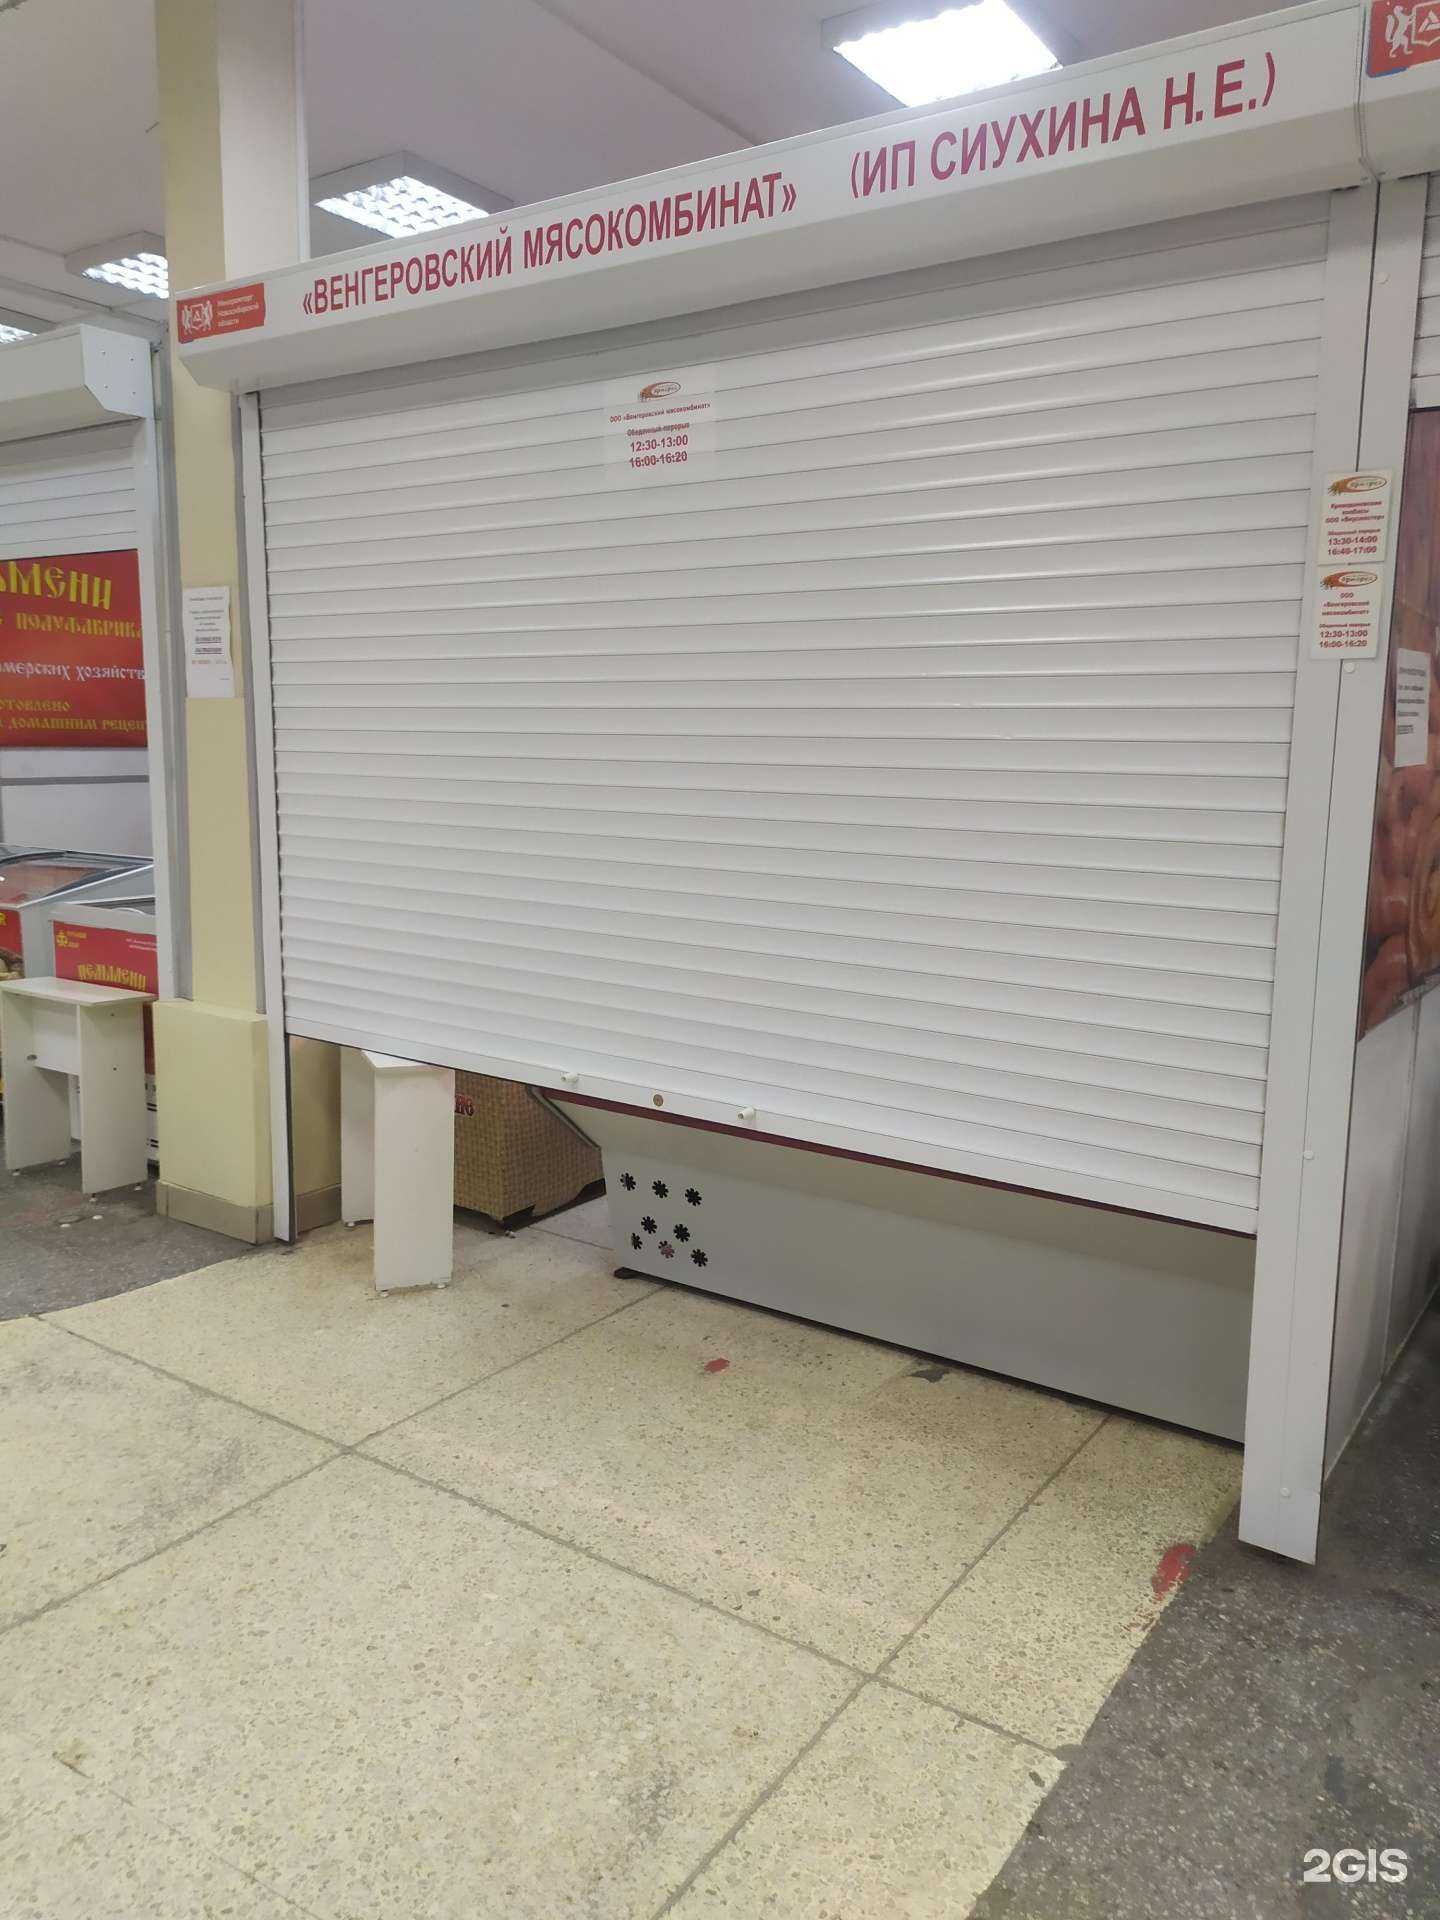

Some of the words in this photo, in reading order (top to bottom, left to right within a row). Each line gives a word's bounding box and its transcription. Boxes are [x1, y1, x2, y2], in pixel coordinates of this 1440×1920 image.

[302, 226, 512, 315] «ВЕНГЕРОВСКИЙ
[524, 171, 797, 269] МЯСОКОМБИНАТ»
[851, 140, 916, 199] (ИП
[930, 86, 1146, 181] СИУХИНА
[609, 415, 622, 423] ООО
[630, 434, 689, 452] 12:30-13:00
[629, 450, 688, 468] 16:00-16:20
[1328, 535, 1379, 546] 13:30-14:00
[1319, 629, 1369, 639] 12:30-13:00
